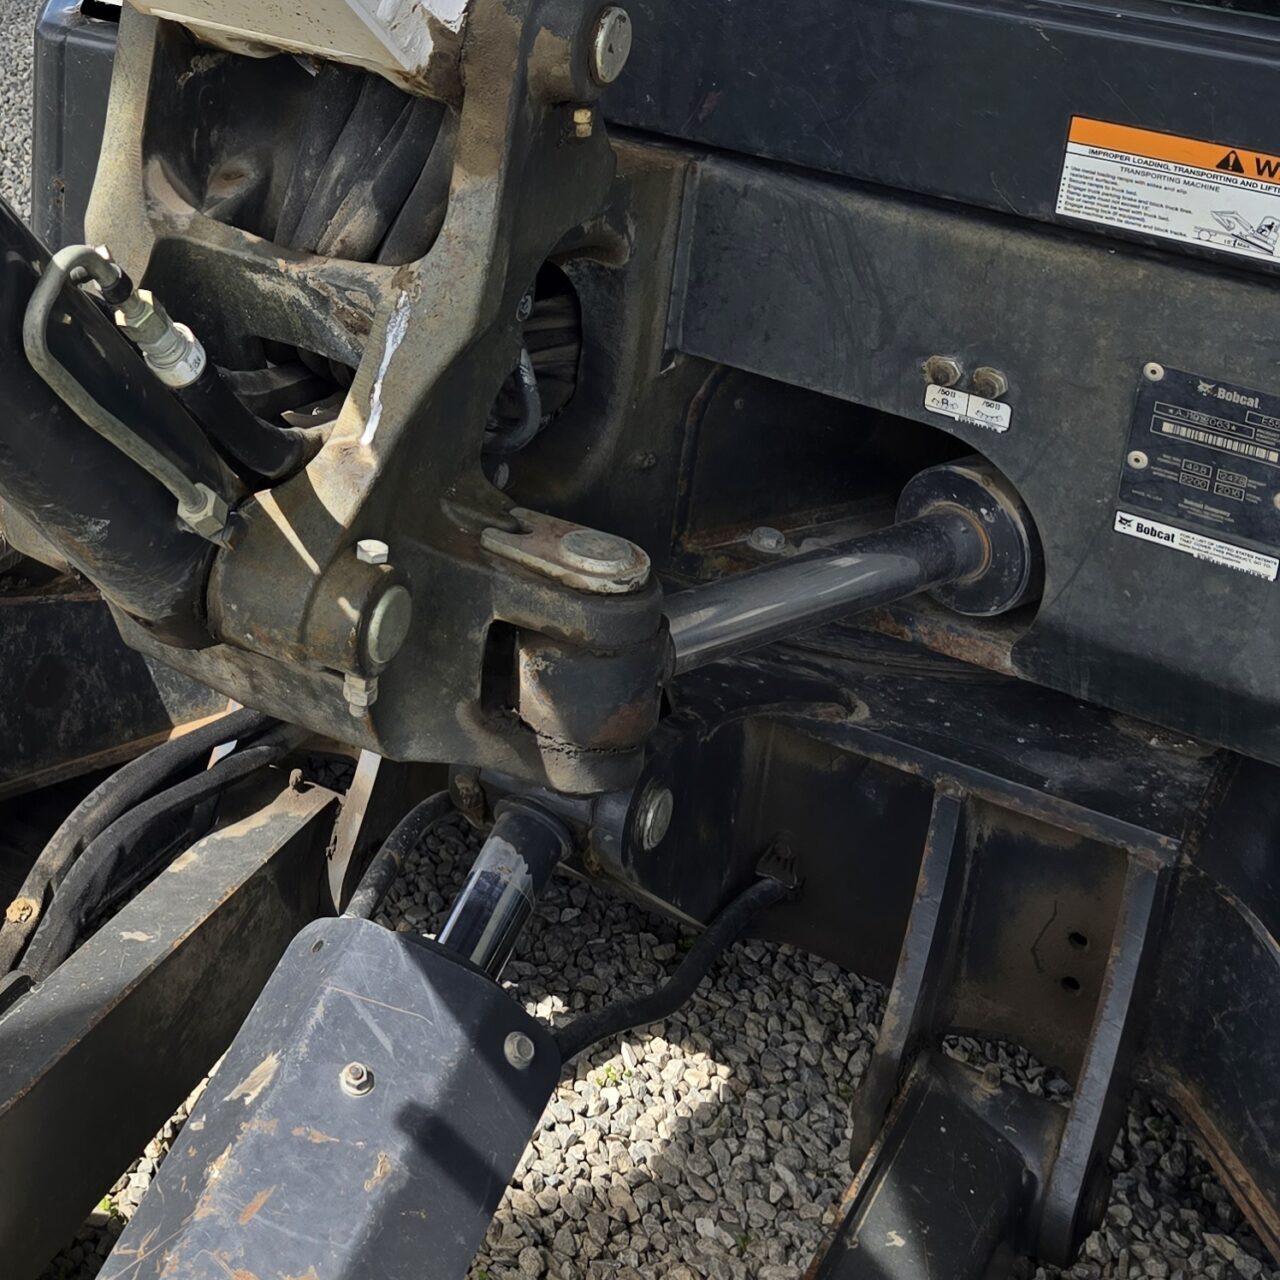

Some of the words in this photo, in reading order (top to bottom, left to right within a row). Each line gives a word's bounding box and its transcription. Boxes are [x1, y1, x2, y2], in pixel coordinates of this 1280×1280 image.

[1088, 148, 1131, 162] IMPROPER
[1132, 158, 1172, 172] LOADING,
[1174, 166, 1238, 184] TRANSPORTING
[1240, 180, 1258, 189] AND
[1120, 166, 1180, 184] TRANSPORTING
[1182, 179, 1220, 193] MACHINE
[1255, 157, 1280, 180] W
[1136, 522, 1175, 543] Bobcat
